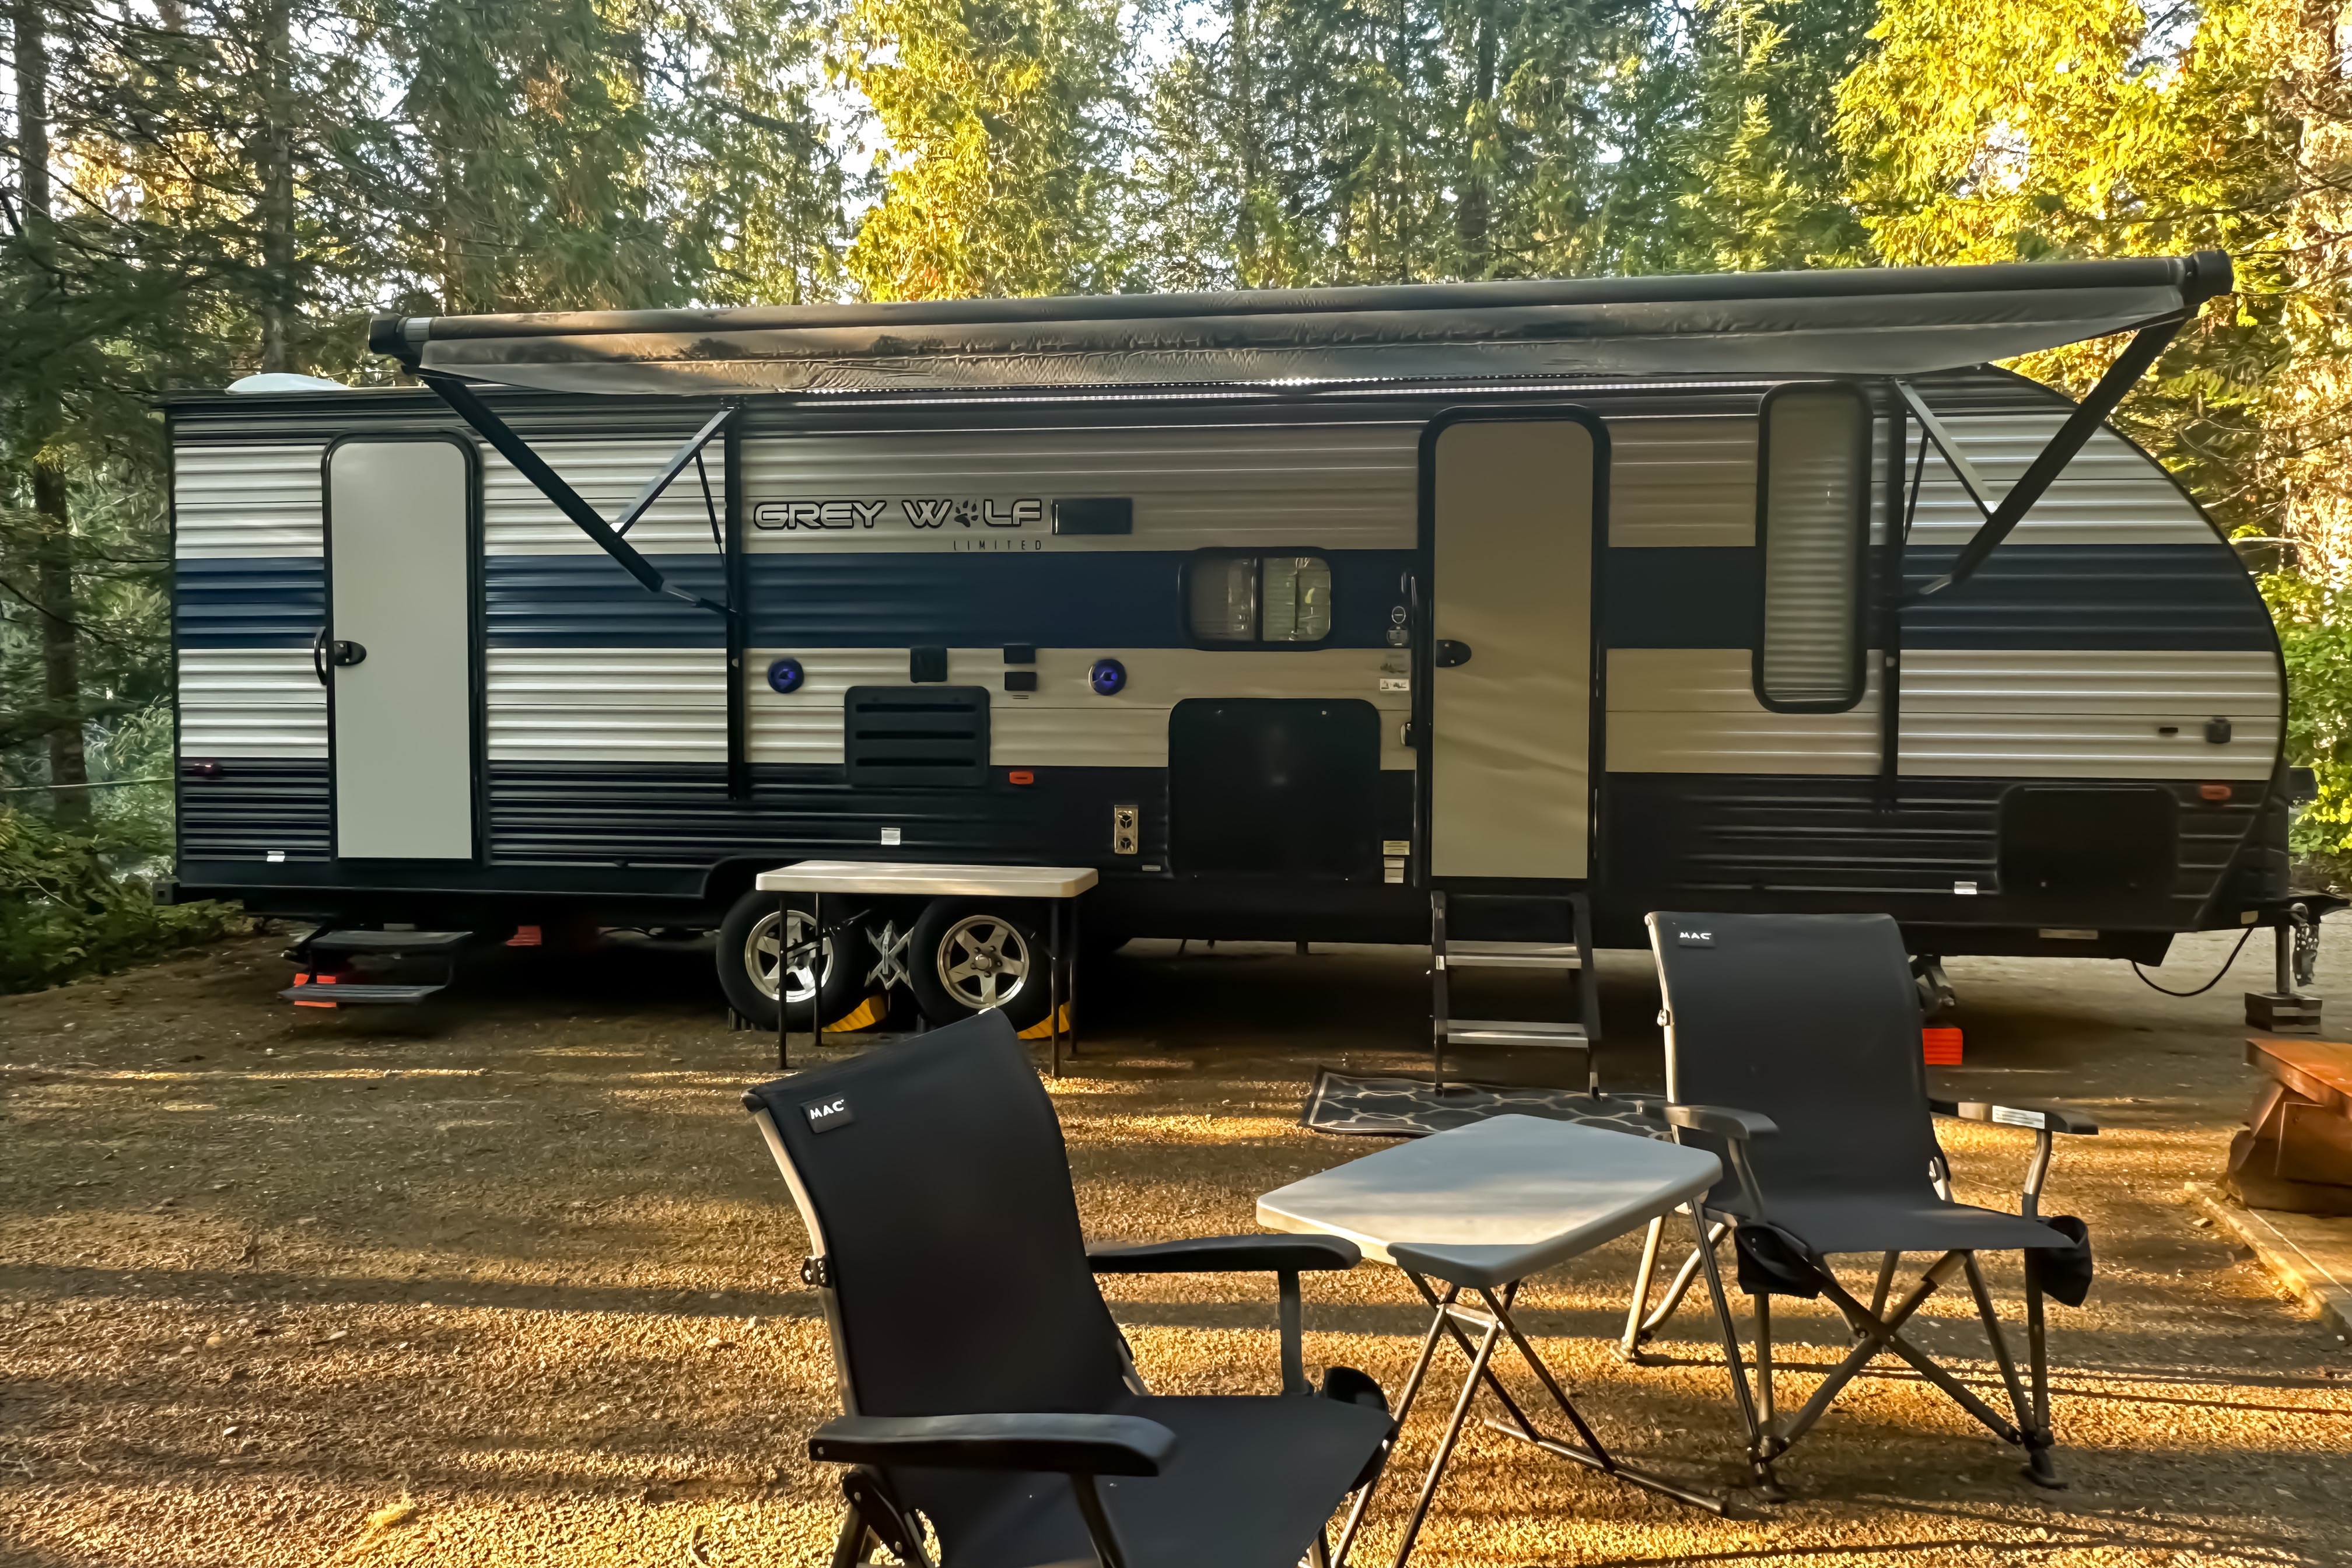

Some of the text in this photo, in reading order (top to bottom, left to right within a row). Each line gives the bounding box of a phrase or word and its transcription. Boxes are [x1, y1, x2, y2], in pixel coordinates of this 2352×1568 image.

[754, 498, 1042, 530] GREY WLF
[953, 540, 1041, 551] LIMITED
[1679, 932, 1712, 940] MAC
[810, 1099, 844, 1119] MAC
